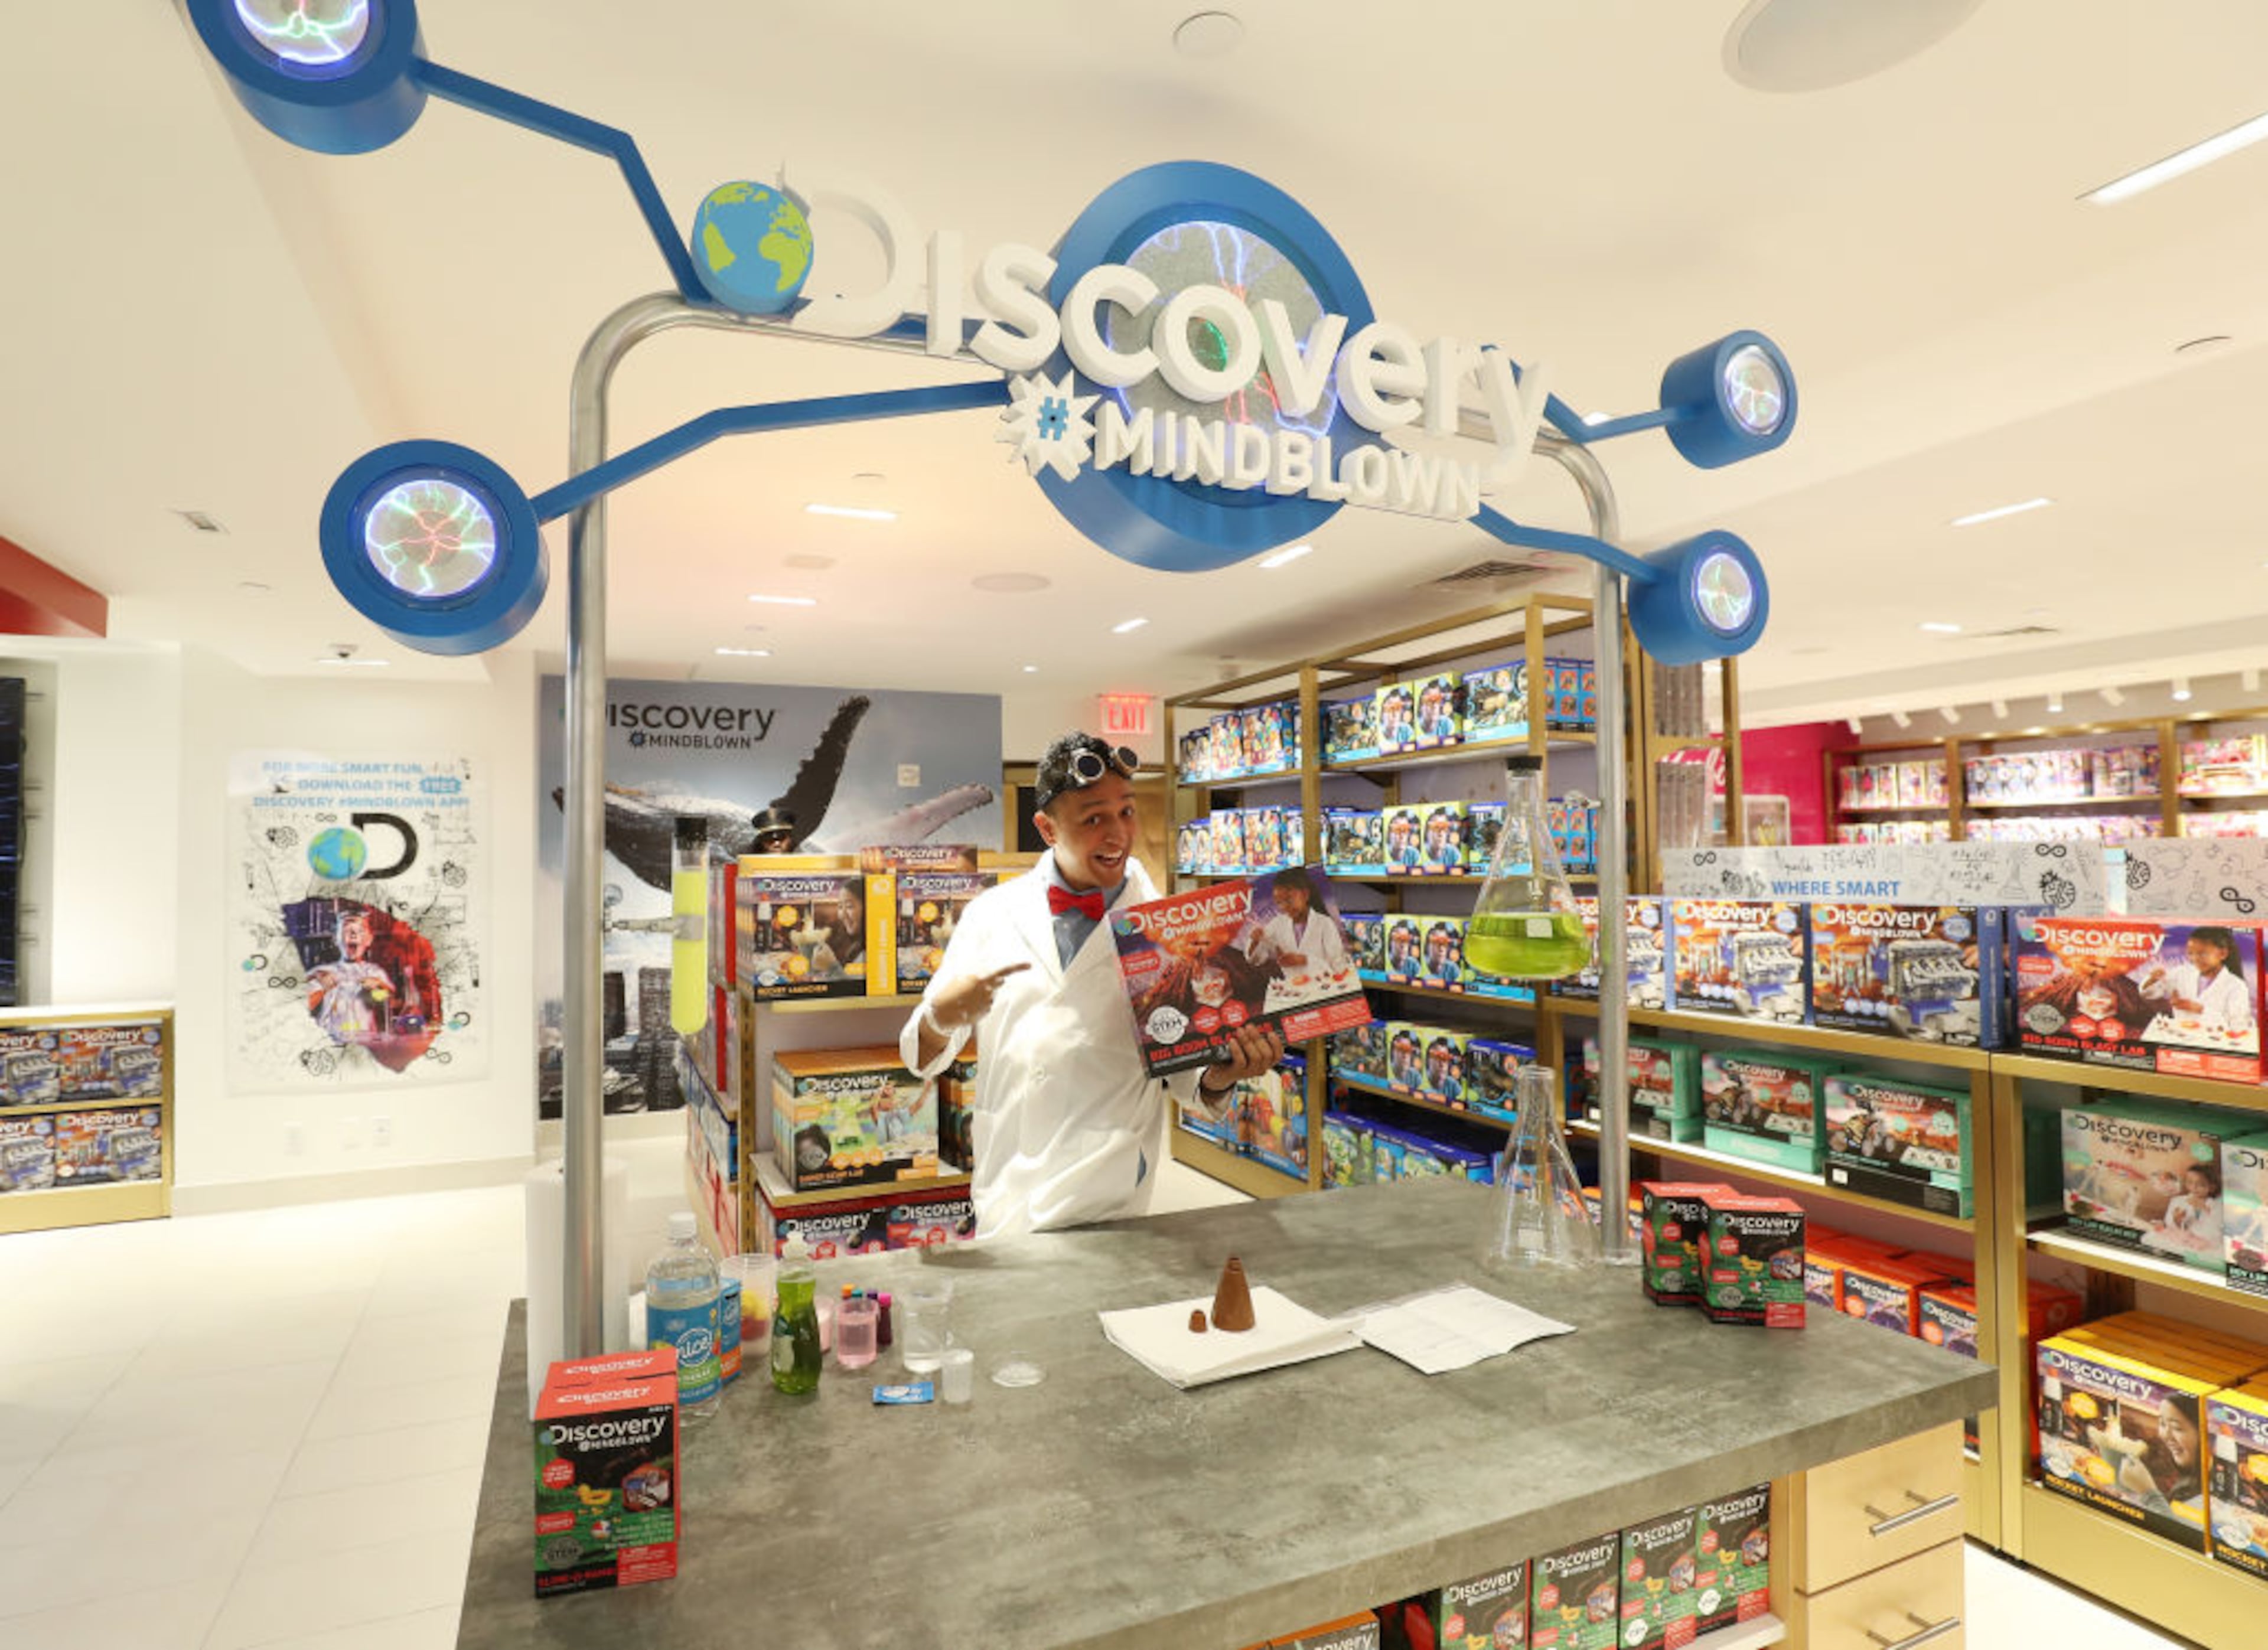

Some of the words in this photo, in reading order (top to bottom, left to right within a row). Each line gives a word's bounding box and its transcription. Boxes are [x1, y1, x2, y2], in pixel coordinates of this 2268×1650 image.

[692, 159, 1555, 470] Discovery
[998, 370, 1481, 519] #MINDBLOWN
[605, 703, 775, 741] iscovery
[1107, 705, 1145, 731] EXIT
[253, 797, 333, 807] DISCOVERY
[758, 878, 835, 893] Discovery
[901, 876, 972, 892] Discovery
[1772, 881, 1831, 896] WHERE
[1836, 880, 1901, 896] SMART
[1116, 888, 1253, 935] Discovery
[1676, 901, 1771, 925] Discovery
[1817, 905, 1937, 933] Discovery
[2021, 922, 2165, 954] Discovery
[62, 1029, 141, 1044] Discovery
[799, 1075, 889, 1094] Discovery
[59, 1113, 139, 1127] Discovery
[2073, 1114, 2182, 1150] Discovery
[780, 1213, 870, 1234] Discovery
[888, 1199, 975, 1221] Discovery
[1716, 1212, 1800, 1232] Discovery
[2036, 1349, 2152, 1399] Discovery
[540, 1416, 666, 1446] Discovery
[1700, 1492, 1768, 1521] Discovery
[1627, 1515, 1694, 1548] Discovery
[1539, 1543, 1615, 1575] Discovery
[1443, 1567, 1522, 1604] Discovery
